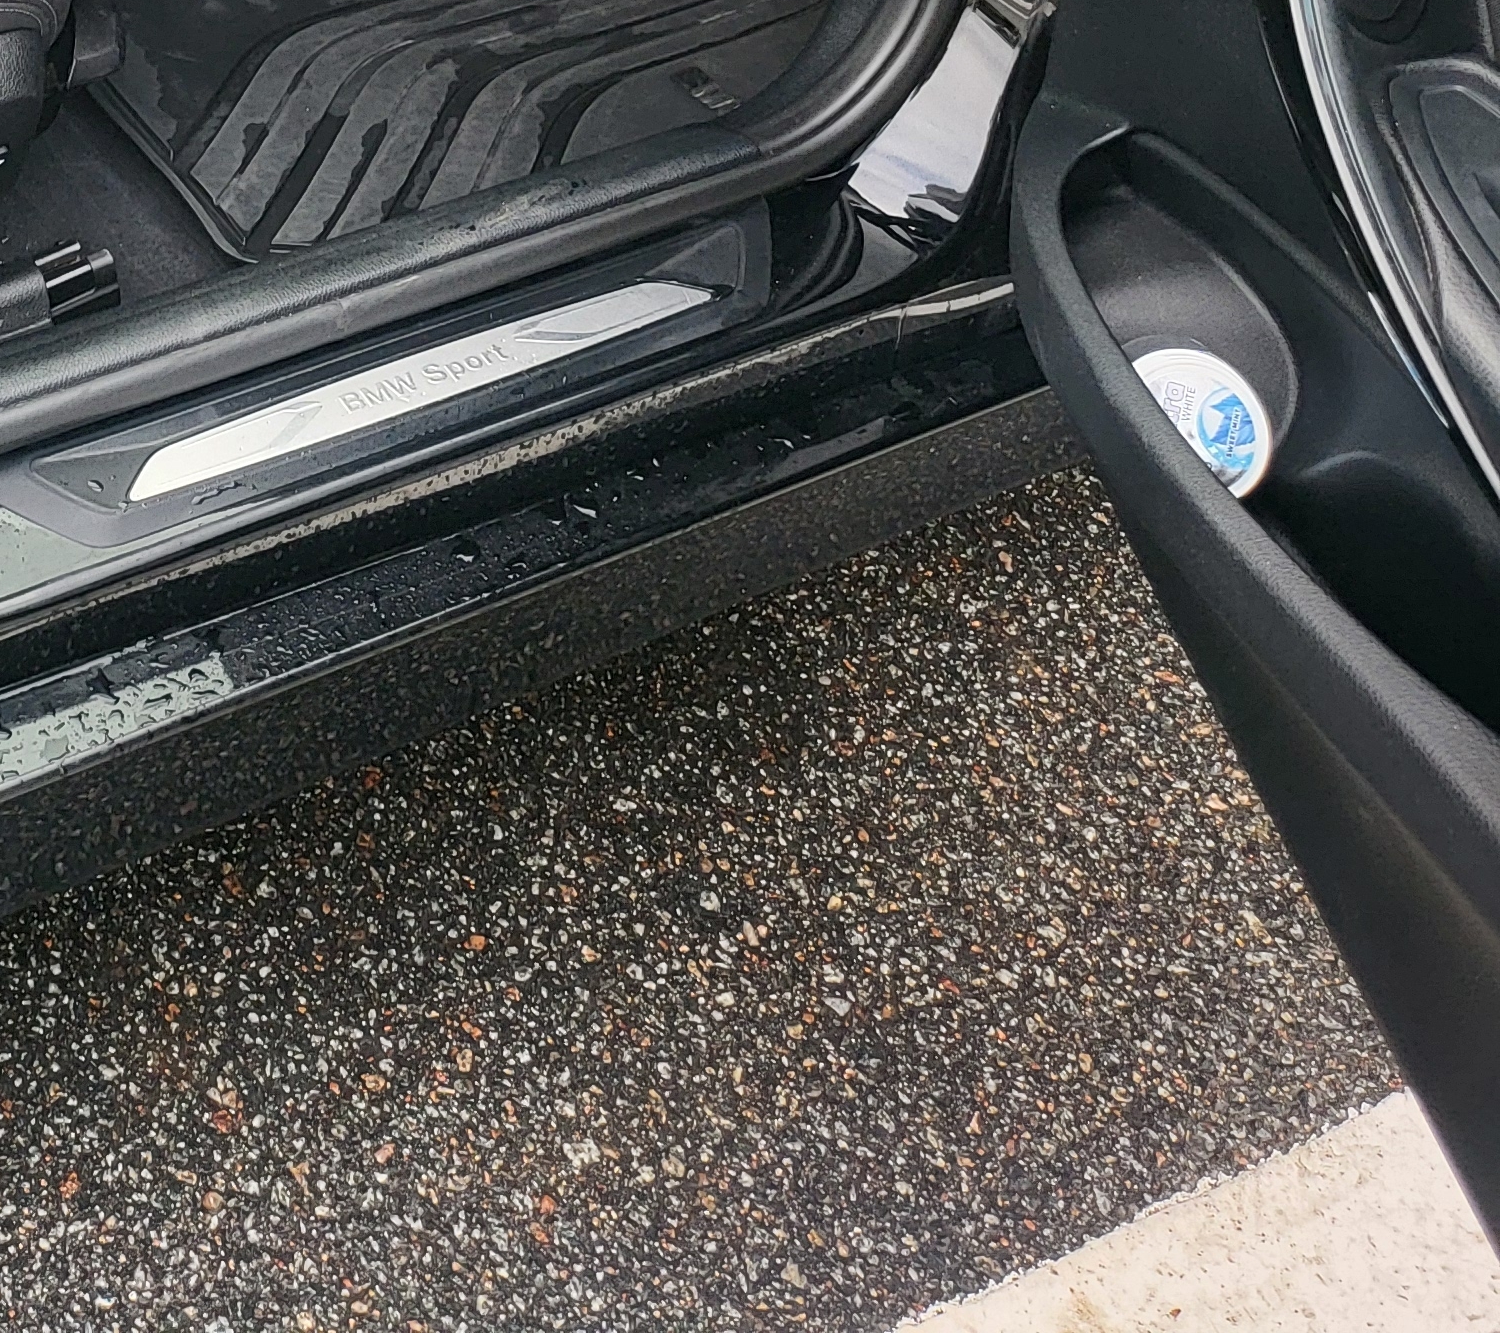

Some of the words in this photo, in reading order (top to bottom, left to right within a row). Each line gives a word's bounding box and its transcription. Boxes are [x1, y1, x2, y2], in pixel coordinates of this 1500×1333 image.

[337, 371, 418, 415] BMW
[421, 343, 510, 384] Sport
[1181, 386, 1196, 421] WHITE
